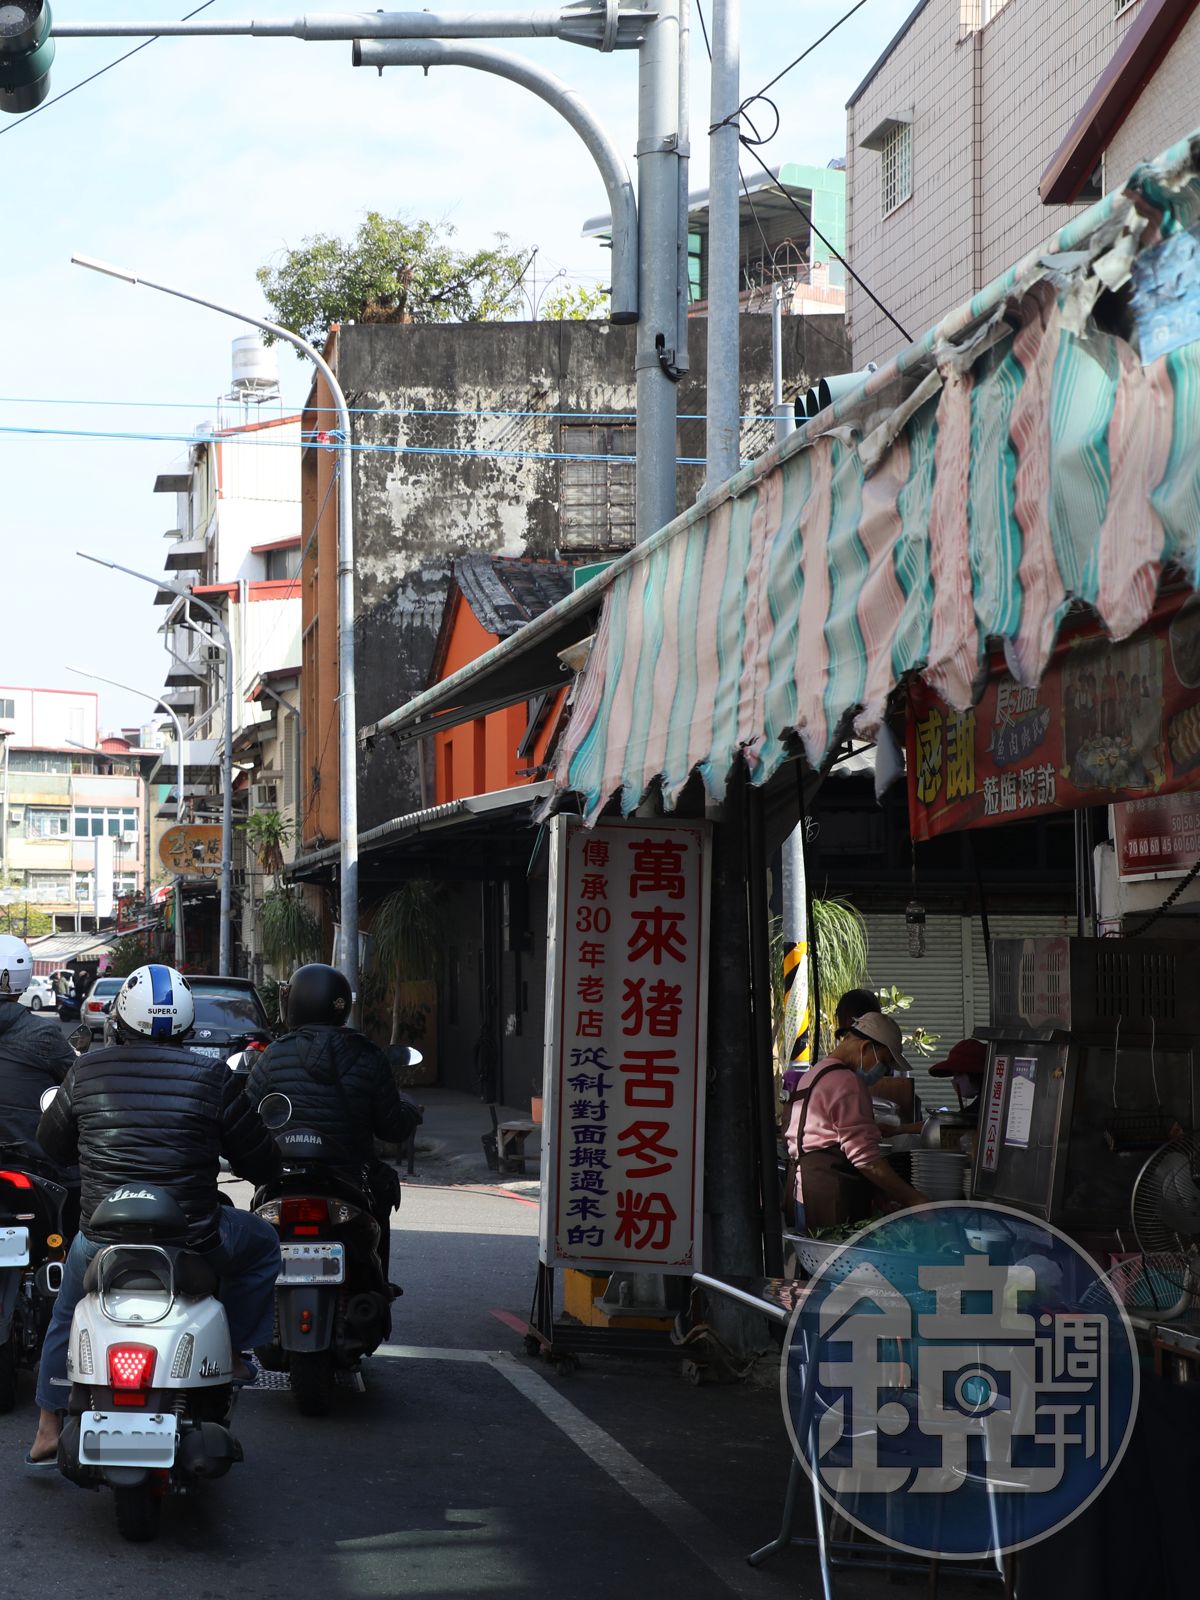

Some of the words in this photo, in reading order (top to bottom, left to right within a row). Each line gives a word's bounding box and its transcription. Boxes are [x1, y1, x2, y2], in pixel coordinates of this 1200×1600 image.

[916, 707, 977, 803] 感謝
[983, 763, 1056, 816] 蒞臨採訪
[1128, 841, 1138, 855] 70
[1139, 840, 1149, 854] 60
[1150, 839, 1160, 853] 60
[1162, 838, 1172, 852] 45
[575, 838, 612, 1038] 傳承30年老店
[614, 838, 689, 1251] 萬來猪舌冬粉
[284, 1134, 323, 1145] YAMAHA
[566, 1047, 614, 1248] 從斜對面搬過來的
